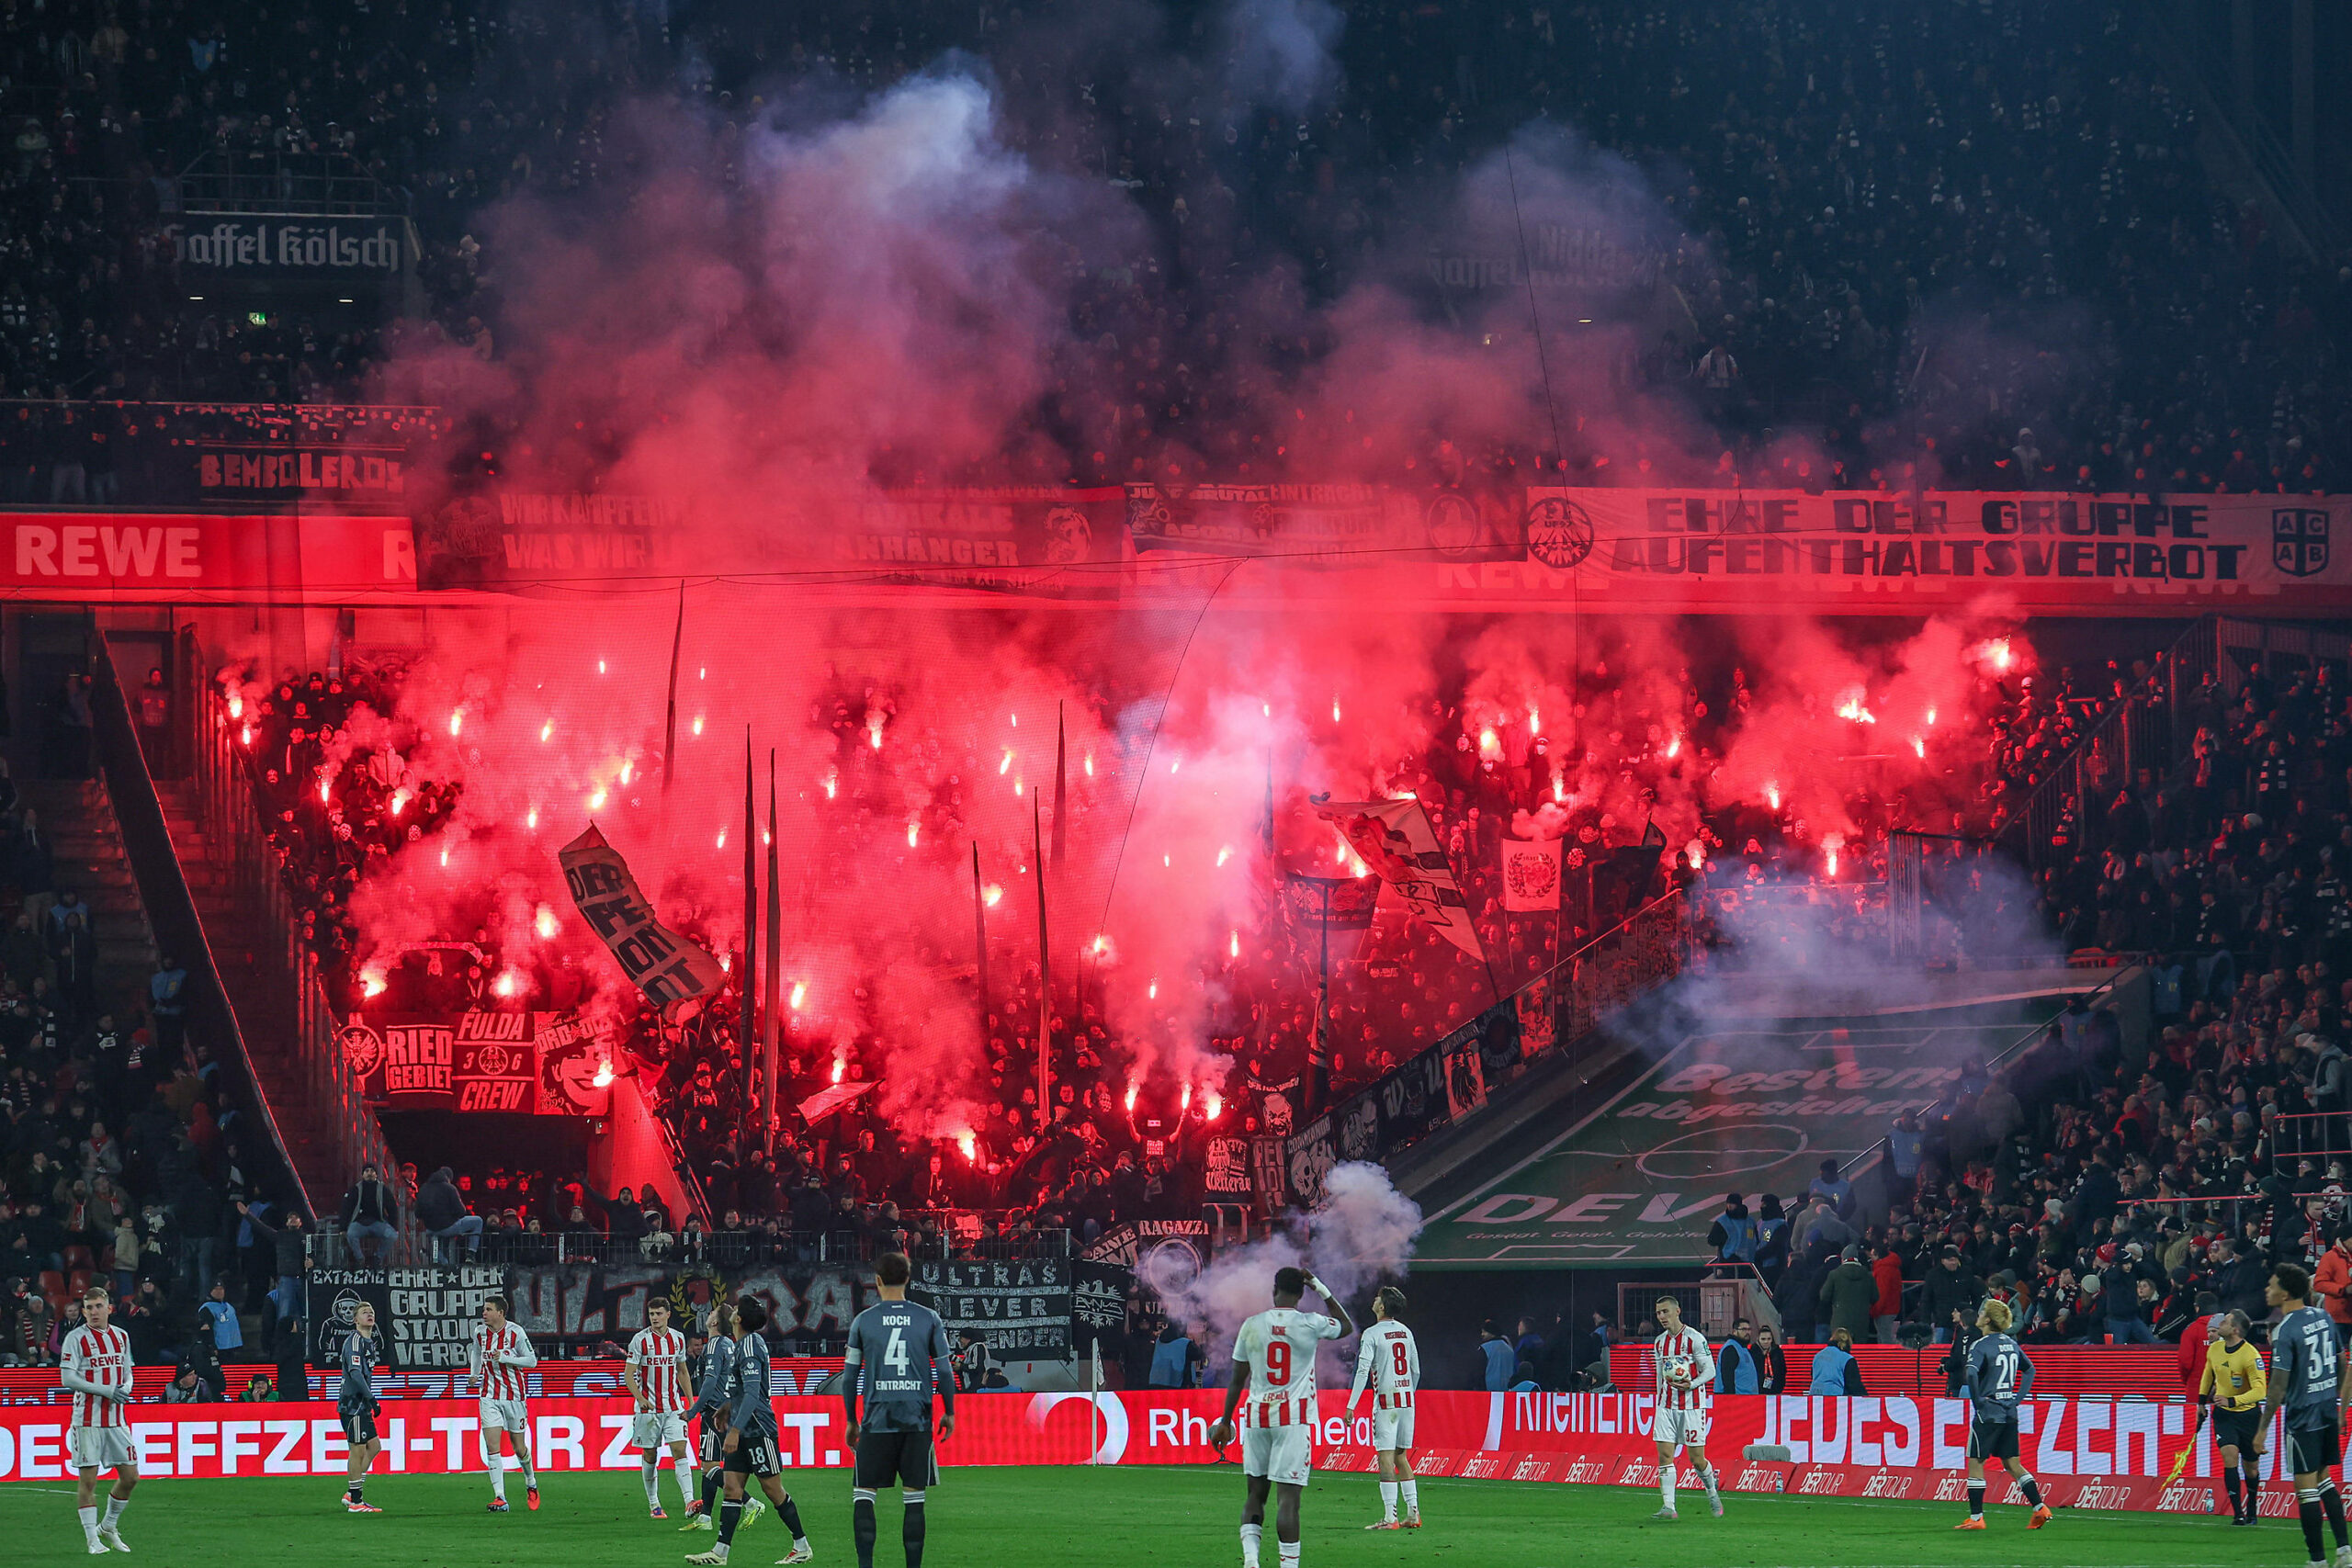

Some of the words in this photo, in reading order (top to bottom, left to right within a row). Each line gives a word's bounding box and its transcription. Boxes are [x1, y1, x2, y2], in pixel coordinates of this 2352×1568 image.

[1833, 499, 1947, 536] DER
[1982, 500, 2210, 538] GRUPPE
[17, 525, 202, 577] REWE
[1611, 537, 2247, 581] AUFENTHALTSVERBOT
[458, 1013, 526, 1041] FULDA
[387, 1030, 454, 1066] RIED
[463, 1052, 474, 1069] 3
[511, 1052, 522, 1070] 6
[389, 1065, 453, 1089] GEBIET
[460, 1082, 526, 1111] CREW
[1138, 1220, 1210, 1236] RAGAZZI
[312, 1269, 385, 1285] EXTREME
[388, 1268, 444, 1288] EHRE
[459, 1266, 504, 1286] DER
[922, 1263, 1057, 1286] ULTRAS
[933, 1296, 1047, 1318] NEVER
[882, 1315, 910, 1326] KOCH
[90, 1355, 124, 1369] REWE
[646, 1357, 673, 1366] REWE
[884, 1327, 910, 1376] 4
[1267, 1341, 1291, 1386] 9
[1392, 1342, 1408, 1375] 8
[2303, 1330, 2336, 1379] 34
[1995, 1353, 2018, 1390] 20
[1685, 1429, 1698, 1443] 32
[126, 1445, 137, 1461] 18
[749, 1446, 766, 1466] 18
[1413, 1454, 1451, 1477] DERTOUR
[1462, 1455, 1499, 1478] DERTOUR
[1511, 1457, 1552, 1483] DERTOUR
[1565, 1459, 1603, 1484] DERTOUR
[1798, 1468, 1845, 1495] DERTOUR
[1861, 1471, 1913, 1499] DERTOUR
[2075, 1481, 2132, 1510] DERTOUR
